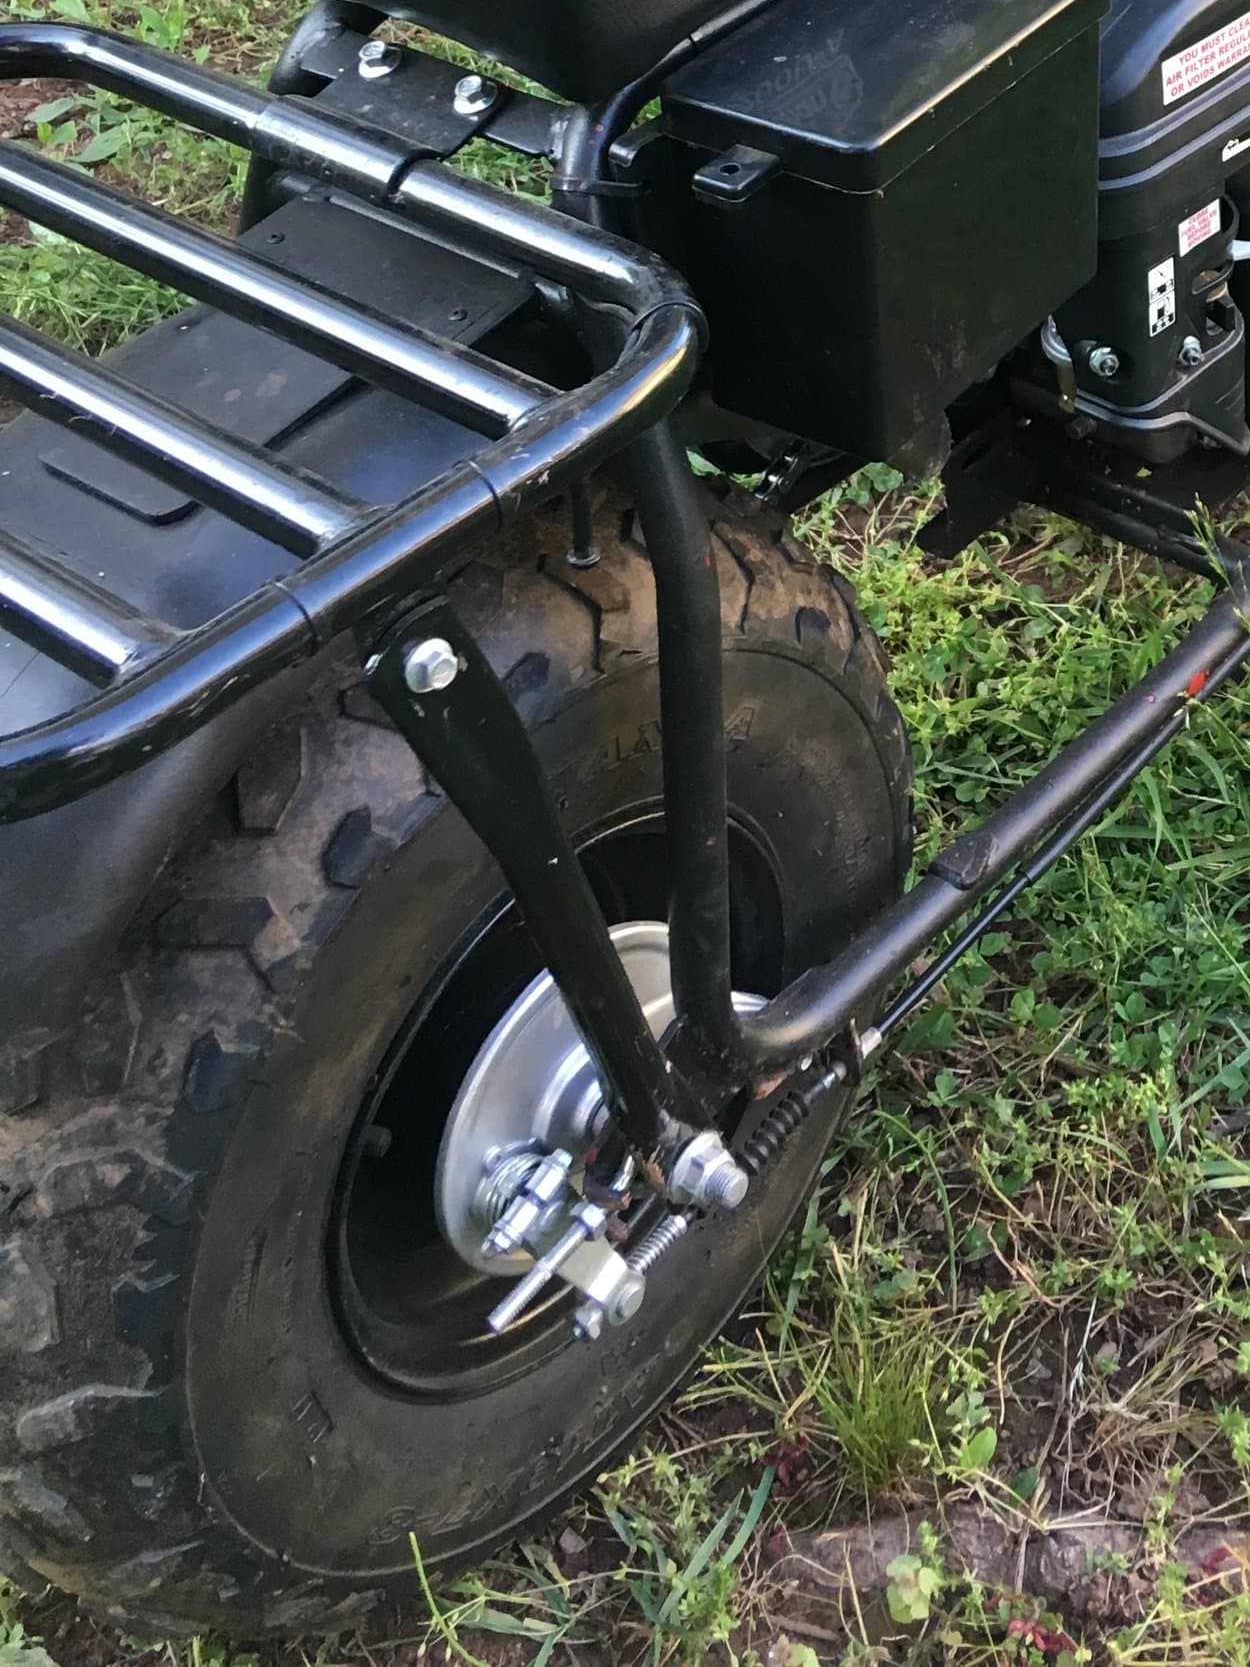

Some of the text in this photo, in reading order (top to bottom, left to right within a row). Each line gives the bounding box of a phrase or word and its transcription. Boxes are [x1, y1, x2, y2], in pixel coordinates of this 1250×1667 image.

[1179, 48, 1198, 65] YOU
[1201, 32, 1226, 52] MUST
[1166, 71, 1182, 86] AIR
[1185, 52, 1216, 75] FILTER
[1171, 83, 1184, 97] OR
[1187, 66, 1215, 87] VOIDS
